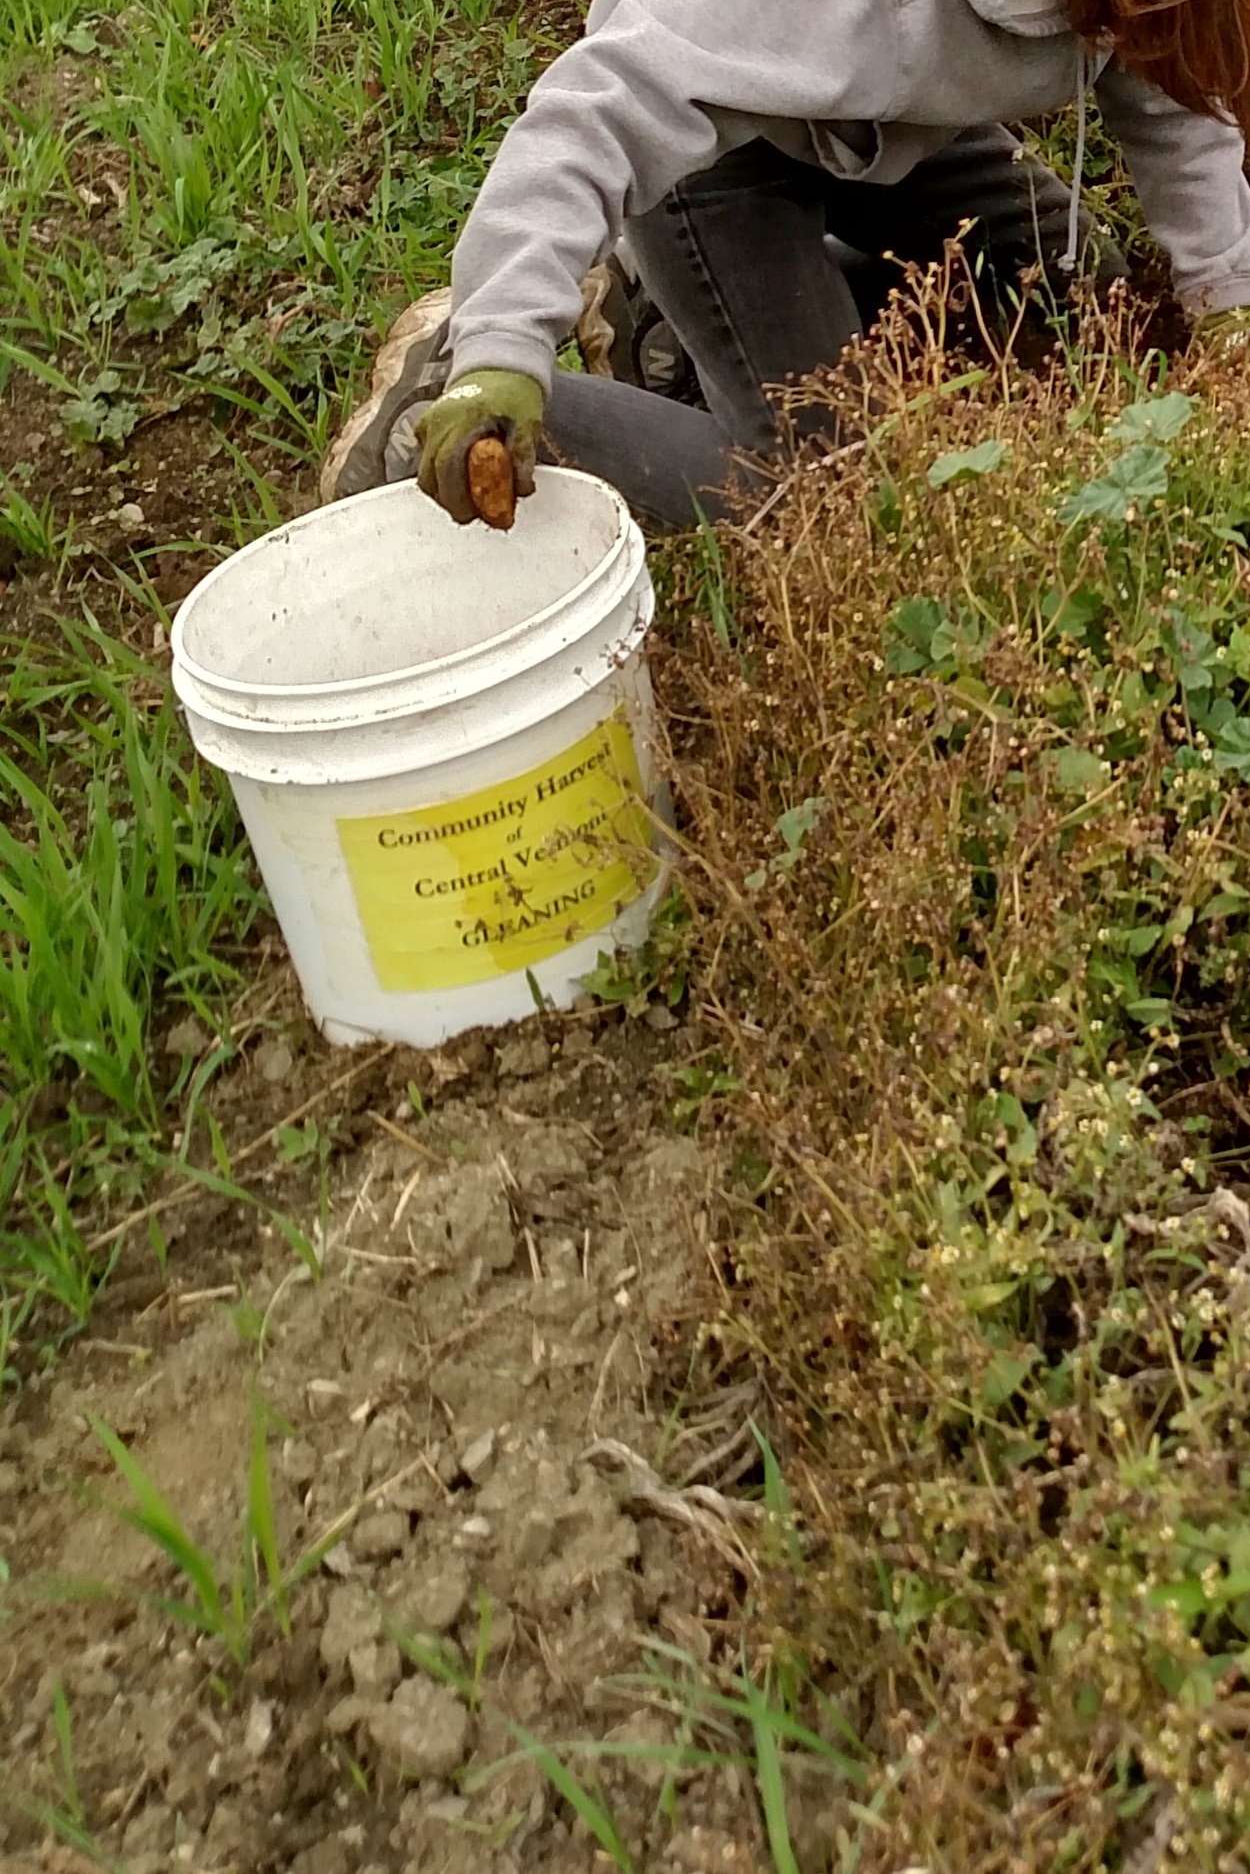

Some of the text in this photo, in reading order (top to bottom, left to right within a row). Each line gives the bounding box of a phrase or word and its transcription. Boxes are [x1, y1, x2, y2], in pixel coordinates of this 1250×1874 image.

[378, 740, 611, 849] Community Harvest
[415, 811, 607, 898] Central Vemont
[506, 825, 523, 843] of
[462, 878, 596, 948] GLEANING
